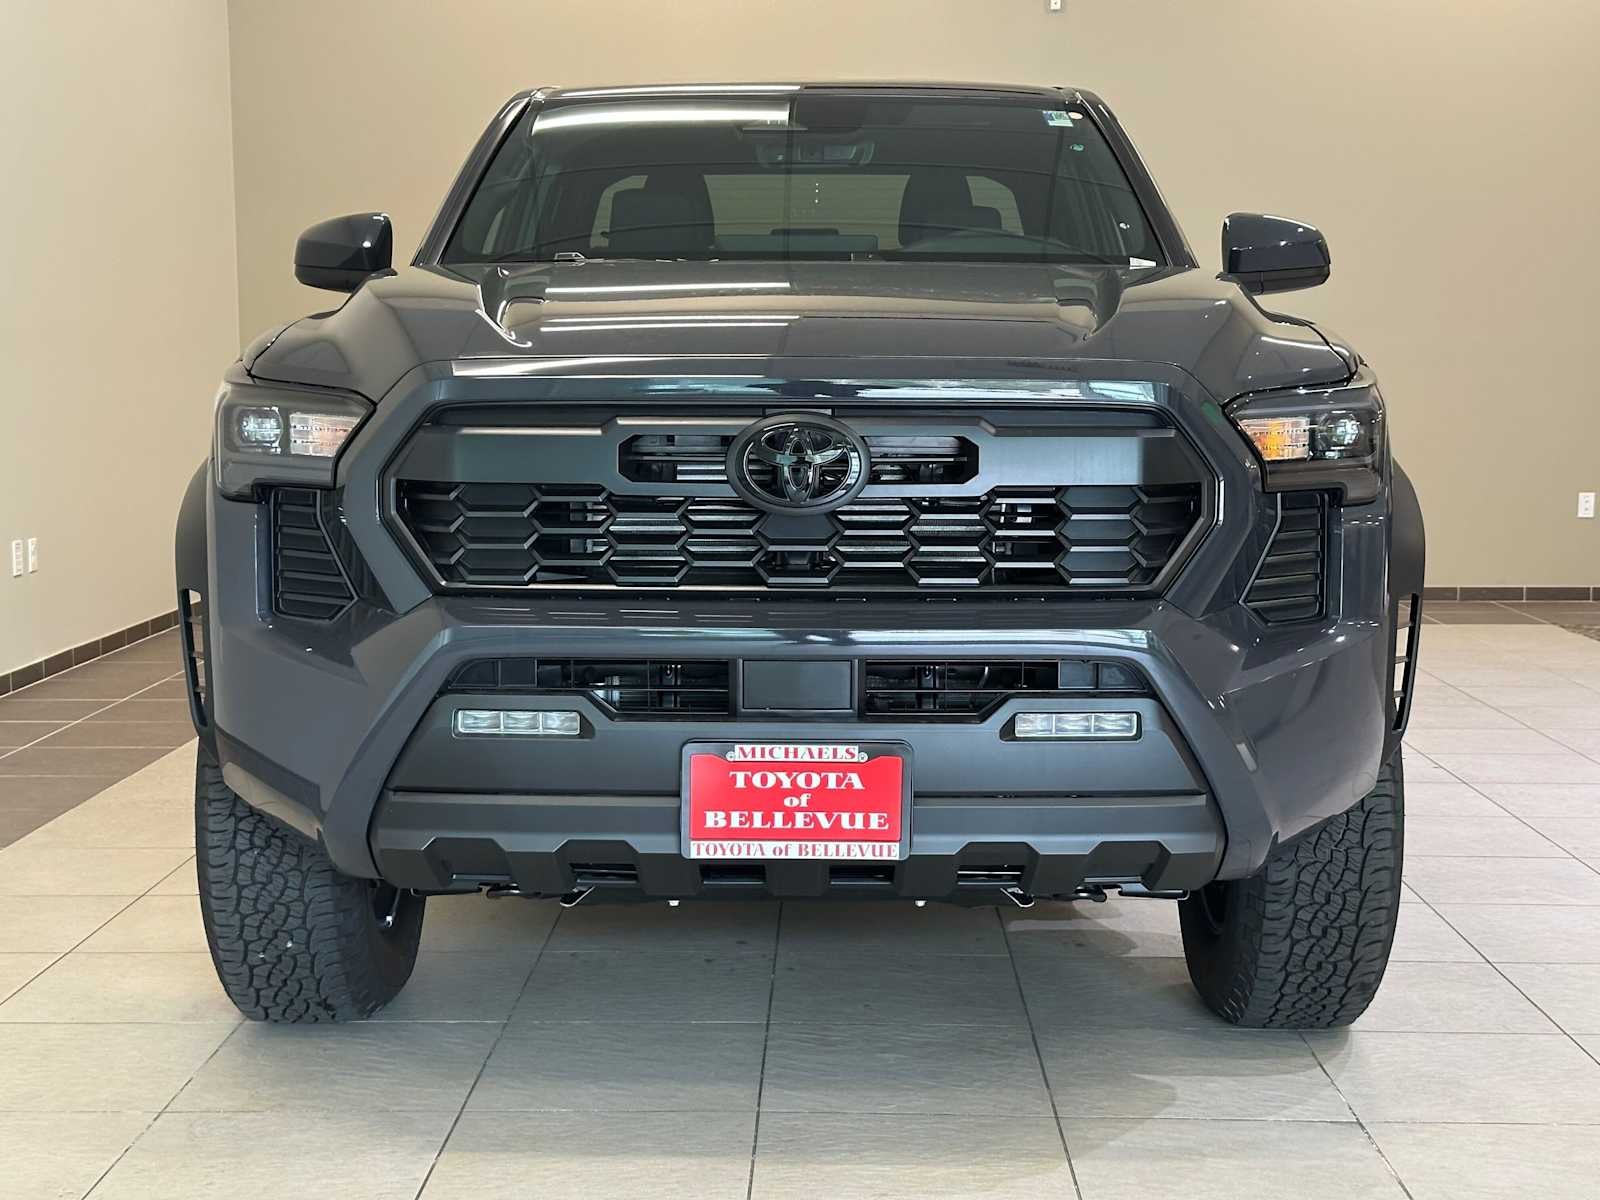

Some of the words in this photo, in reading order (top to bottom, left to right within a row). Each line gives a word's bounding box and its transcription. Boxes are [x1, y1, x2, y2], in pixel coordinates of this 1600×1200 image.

[737, 746, 857, 760] MICHAELS
[729, 771, 865, 790] TOYOTA
[783, 793, 811, 808] of
[704, 811, 889, 830] BELLEVUE
[692, 843, 766, 857] TOYOTA
[772, 843, 792, 857] of
[798, 844, 897, 858] BELLEVUE
